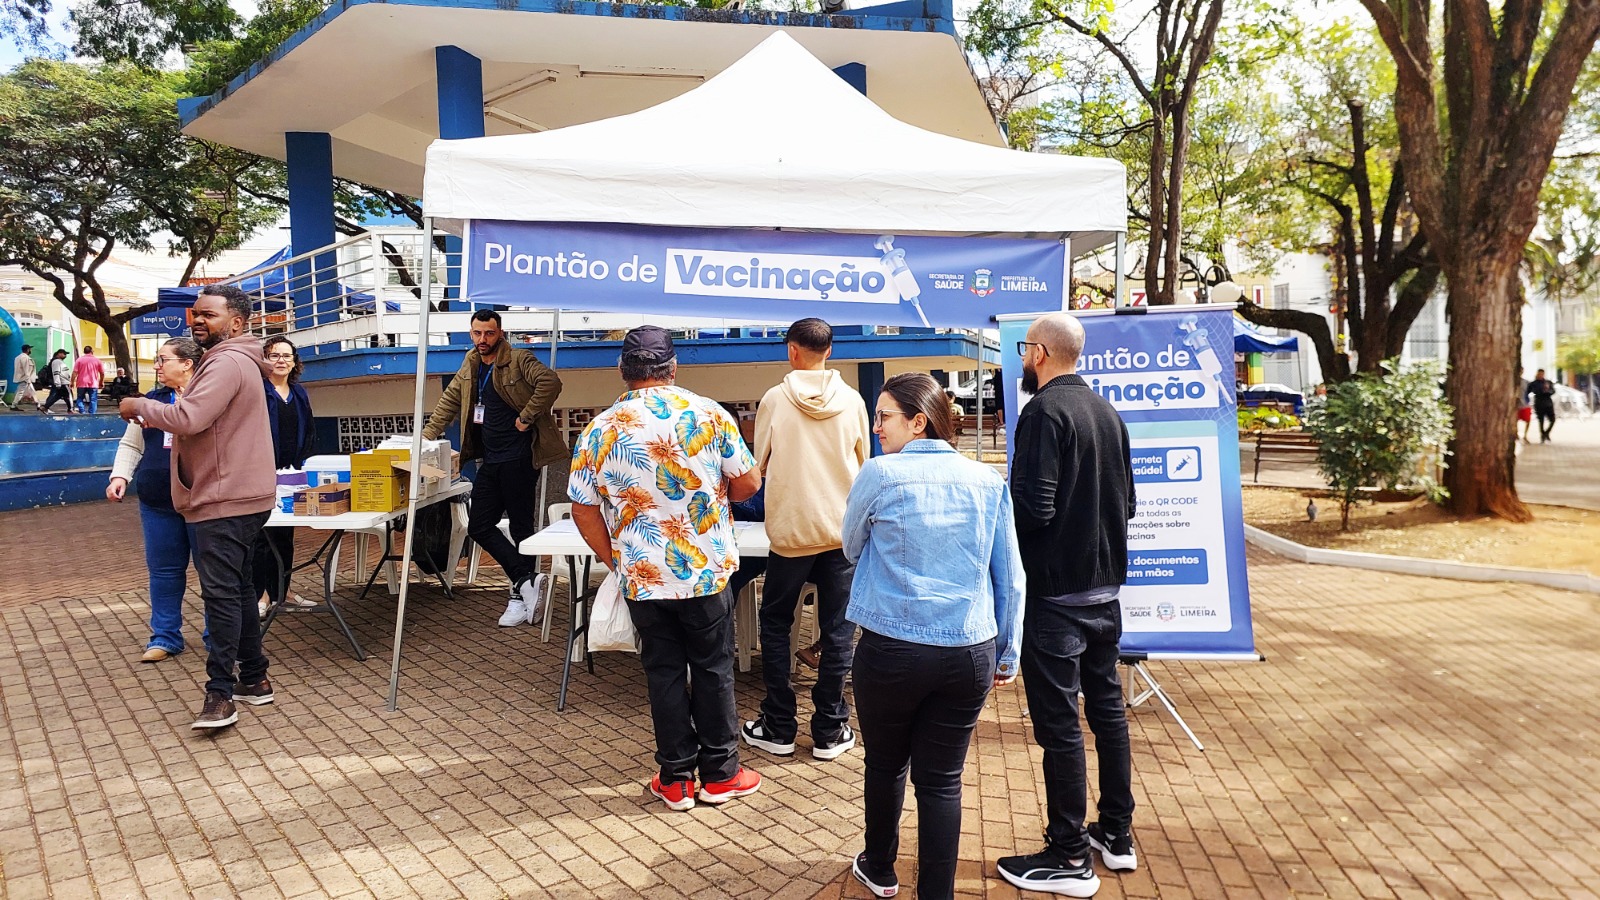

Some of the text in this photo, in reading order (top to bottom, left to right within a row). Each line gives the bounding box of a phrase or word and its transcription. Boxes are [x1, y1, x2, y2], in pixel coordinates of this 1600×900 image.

[484, 242, 885, 300] Plantão de Vacinação
[934, 279, 964, 290] SAÚDE
[1000, 281, 1047, 292] LIMEIRA
[1076, 343, 1190, 371] antão de
[1092, 376, 1206, 407] inação
[1131, 455, 1163, 465] erneta
[1156, 498, 1169, 506] QR
[1171, 497, 1198, 505] CODE
[1146, 509, 1170, 517] todas
[1165, 520, 1190, 528] sobre
[1127, 532, 1156, 540] acinas
[1133, 555, 1200, 566] documentos
[1126, 567, 1175, 578] em mãos
[1129, 609, 1151, 618] SAÚDE
[1180, 609, 1217, 617] LIMEIRA
